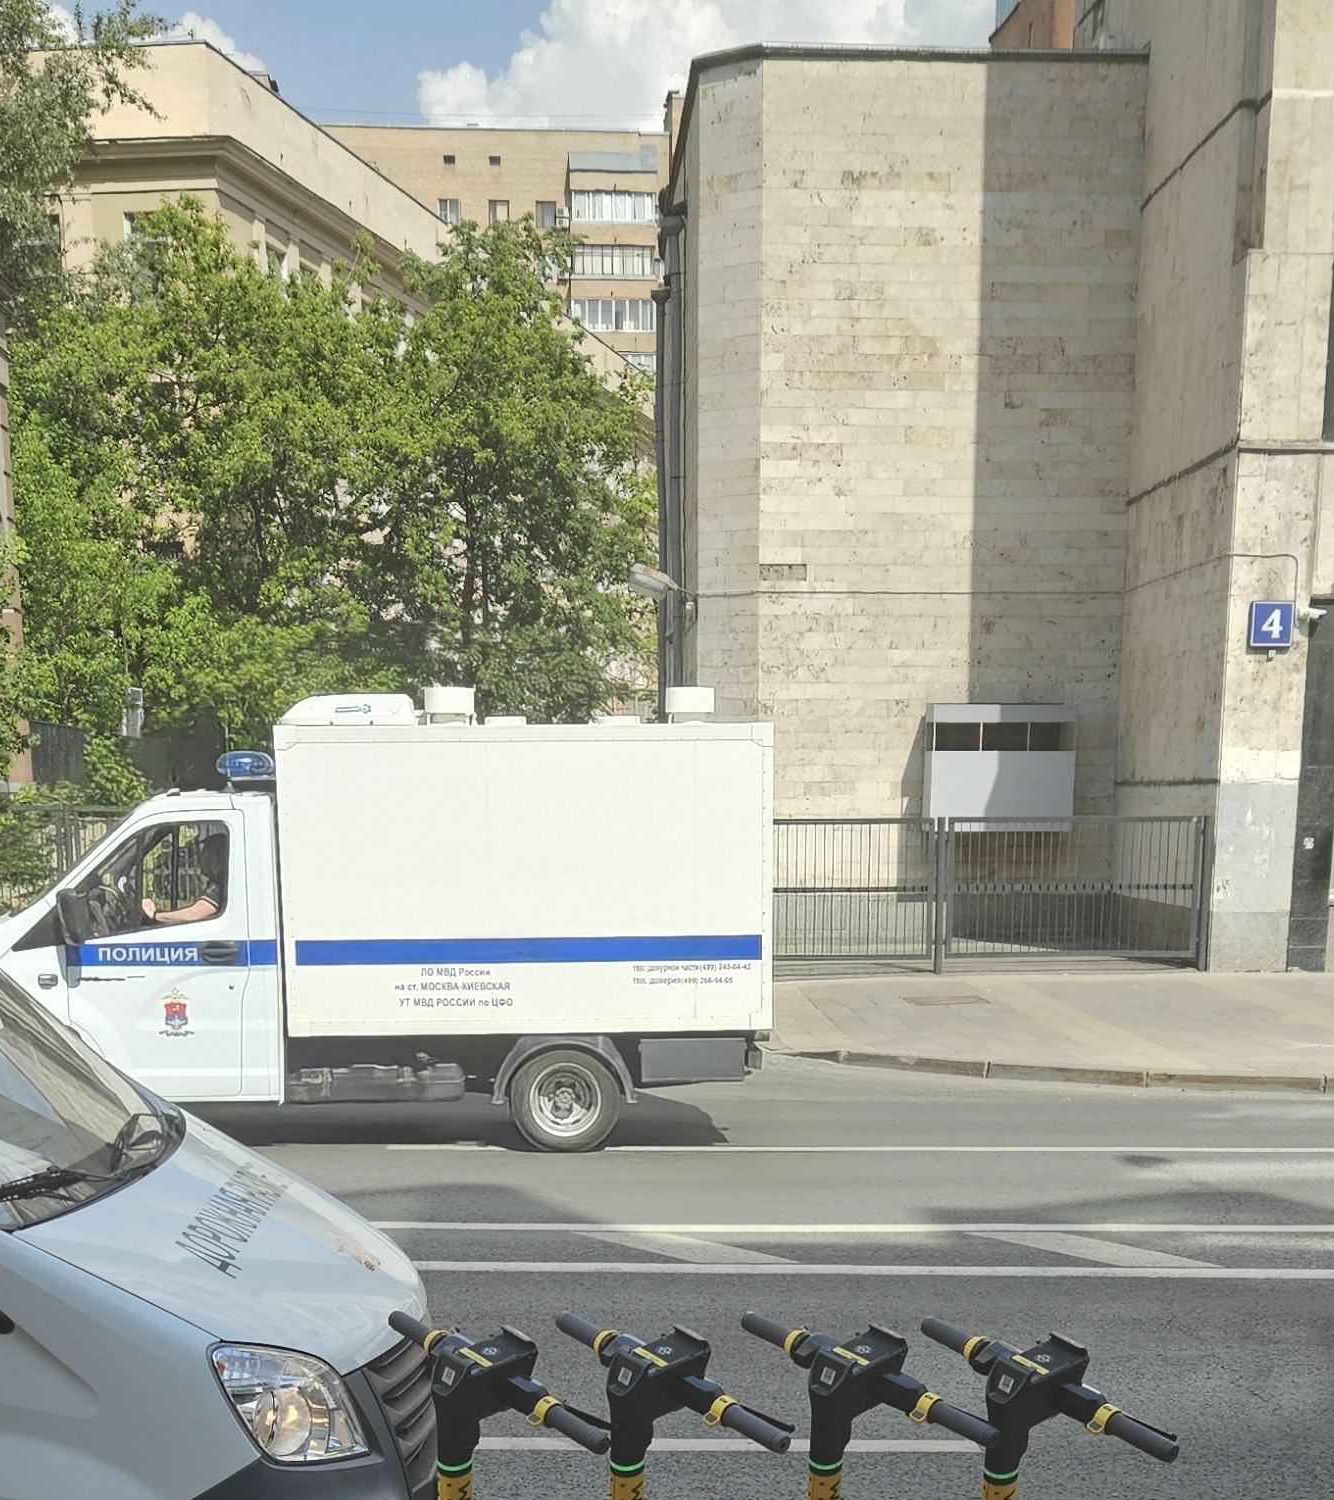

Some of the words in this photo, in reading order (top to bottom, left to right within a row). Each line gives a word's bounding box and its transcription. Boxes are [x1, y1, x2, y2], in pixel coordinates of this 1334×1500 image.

[1261, 608, 1284, 639] 4
[98, 946, 198, 965] ПОЛИЦИЯ
[420, 967, 434, 977] ЛО
[436, 967, 457, 978] МВД
[458, 967, 491, 977] России
[394, 982, 406, 992] на
[420, 981, 512, 992] МОСКВА-КИЕВСКАЯ
[398, 997, 411, 1008] УТ
[413, 997, 435, 1009] МВД
[436, 997, 477, 1008] РОССИИ
[478, 999, 490, 1008] по
[491, 997, 514, 1009] ЦФО
